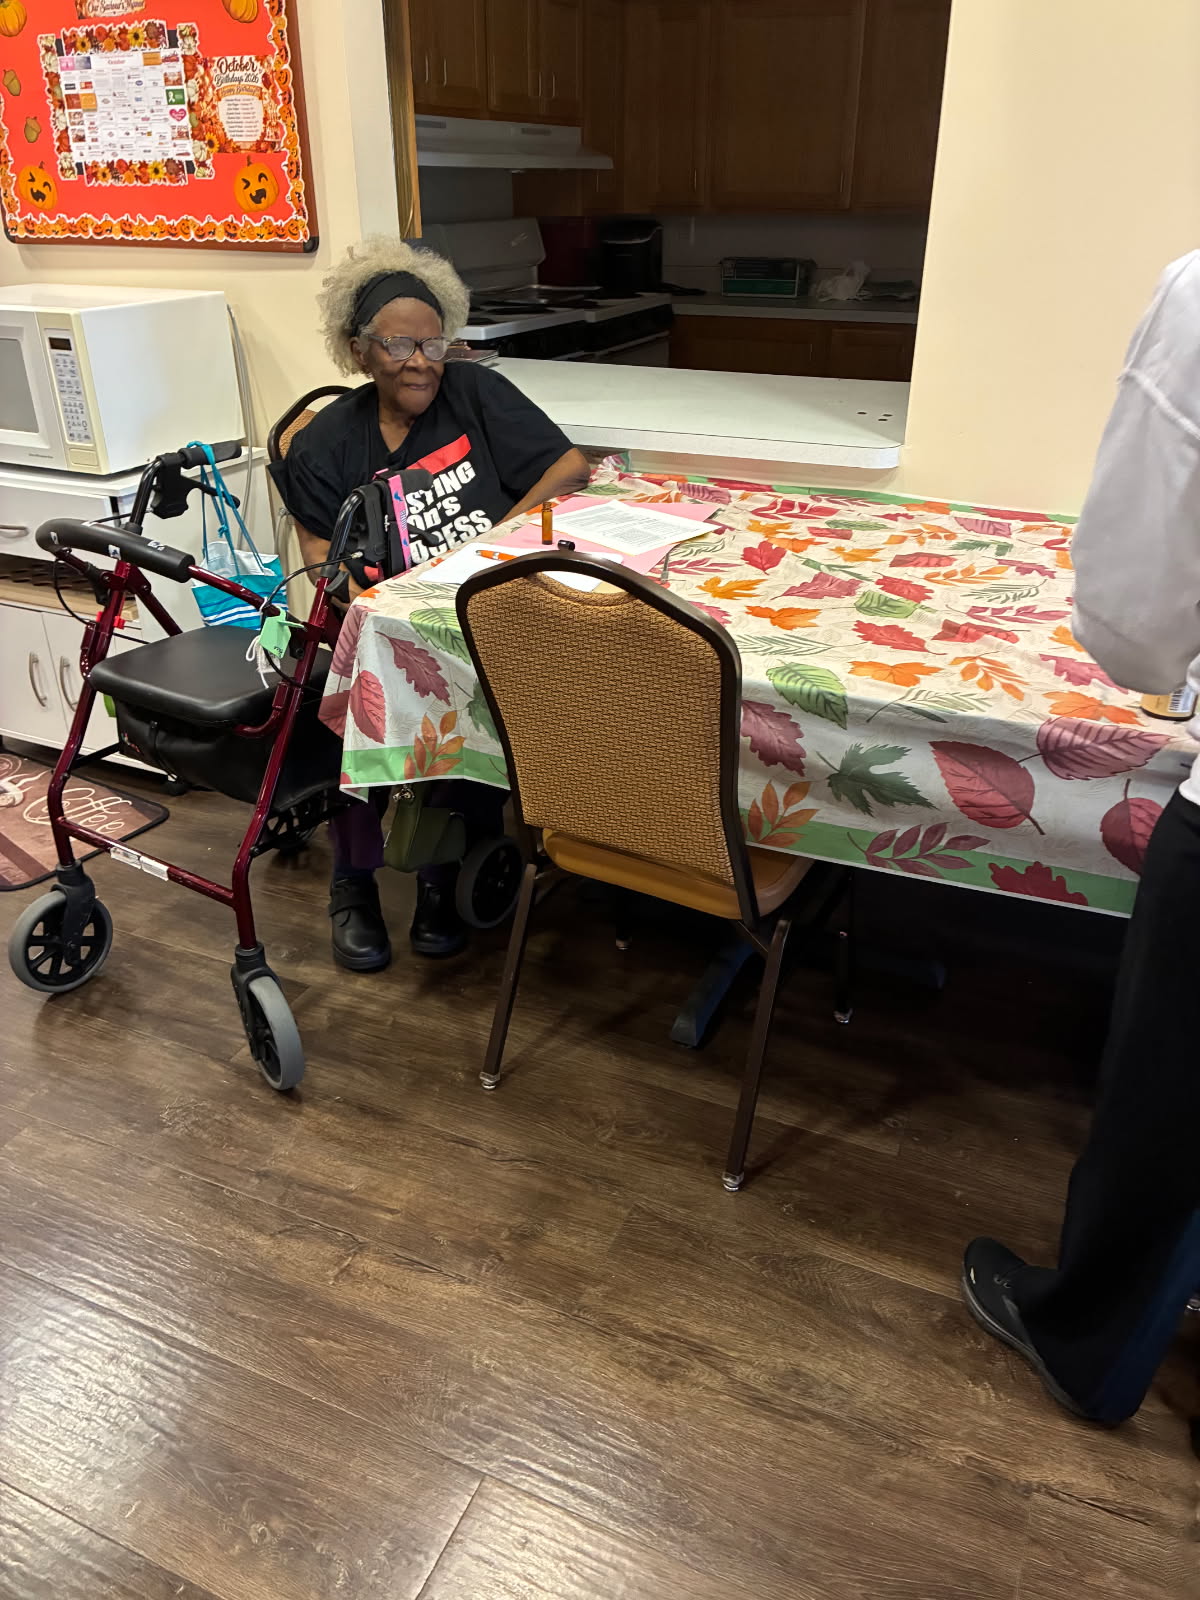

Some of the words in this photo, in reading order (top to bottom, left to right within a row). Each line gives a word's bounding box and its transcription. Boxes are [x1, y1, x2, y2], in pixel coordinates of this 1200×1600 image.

[217, 56, 257, 75] October
[405, 461, 476, 515] STING
[407, 496, 462, 538] OD'S
[410, 509, 493, 565] OCESS
